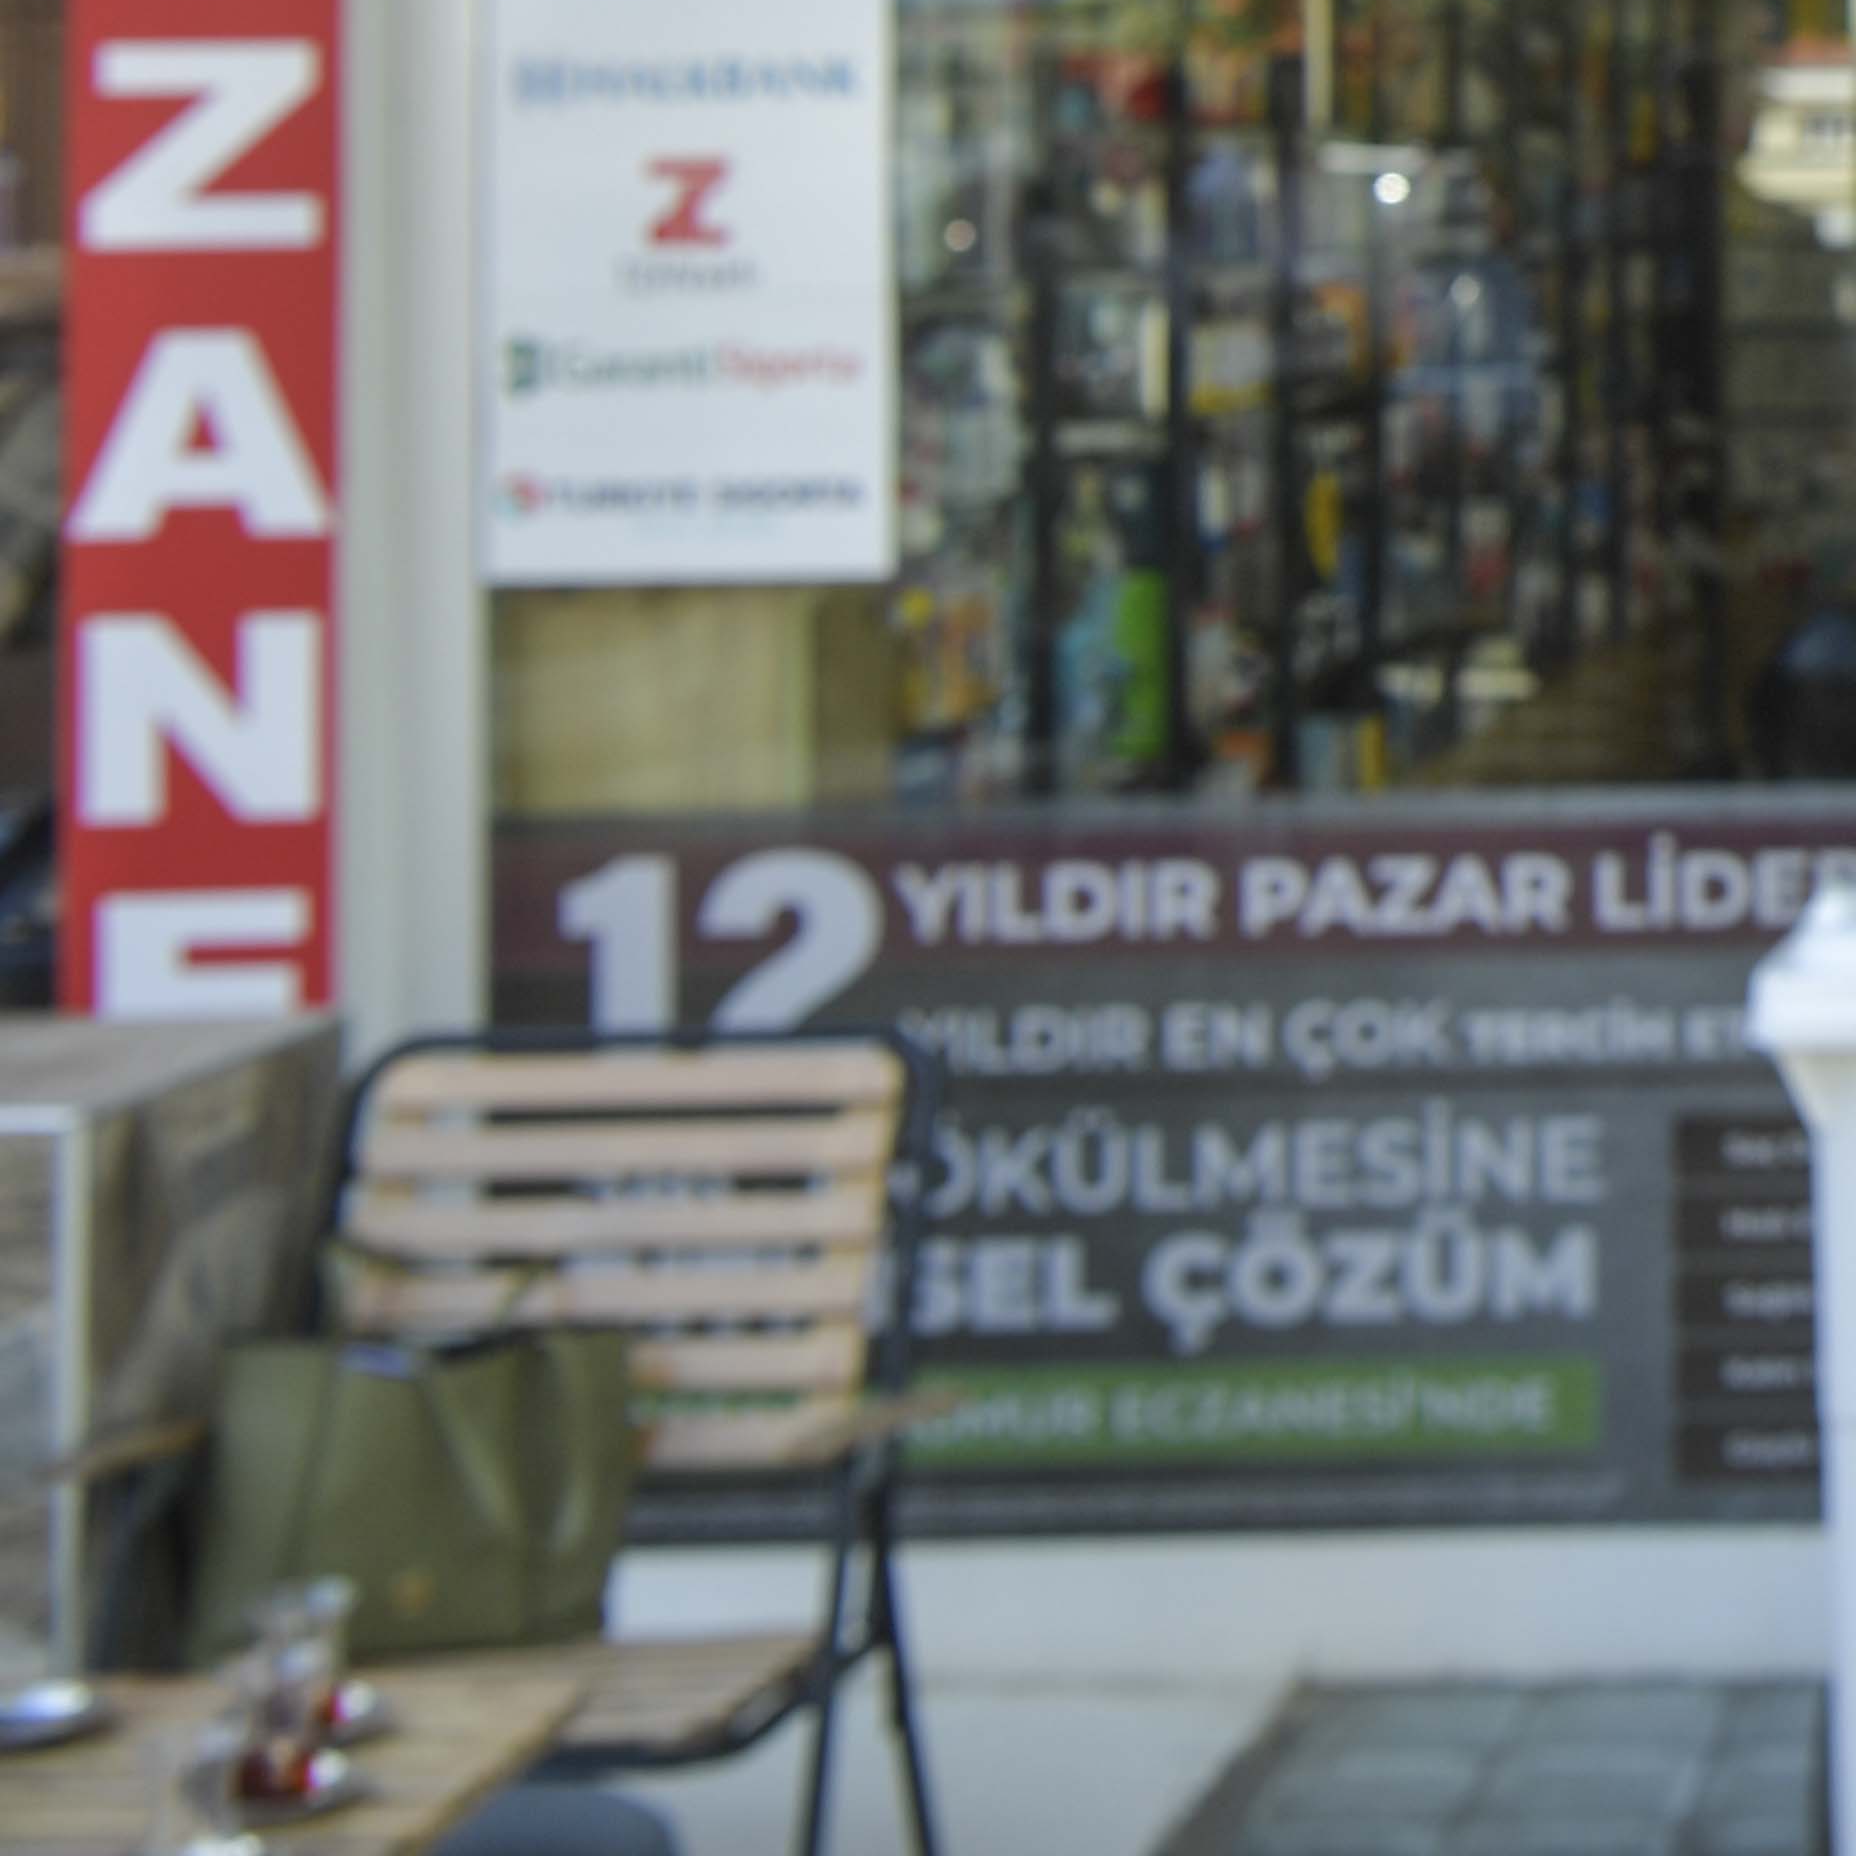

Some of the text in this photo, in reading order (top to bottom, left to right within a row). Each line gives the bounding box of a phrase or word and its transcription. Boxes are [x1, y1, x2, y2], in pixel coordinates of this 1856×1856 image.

[558, 846, 885, 1034] 12
[893, 858, 1219, 944] YILDIR
[1240, 847, 1573, 940] PAZAR
[1284, 997, 1456, 1082] ÇOK
[888, 1099, 1603, 1214] ÖKÜLMESİNE
[1141, 1204, 1596, 1354] ÇÖZÜM
